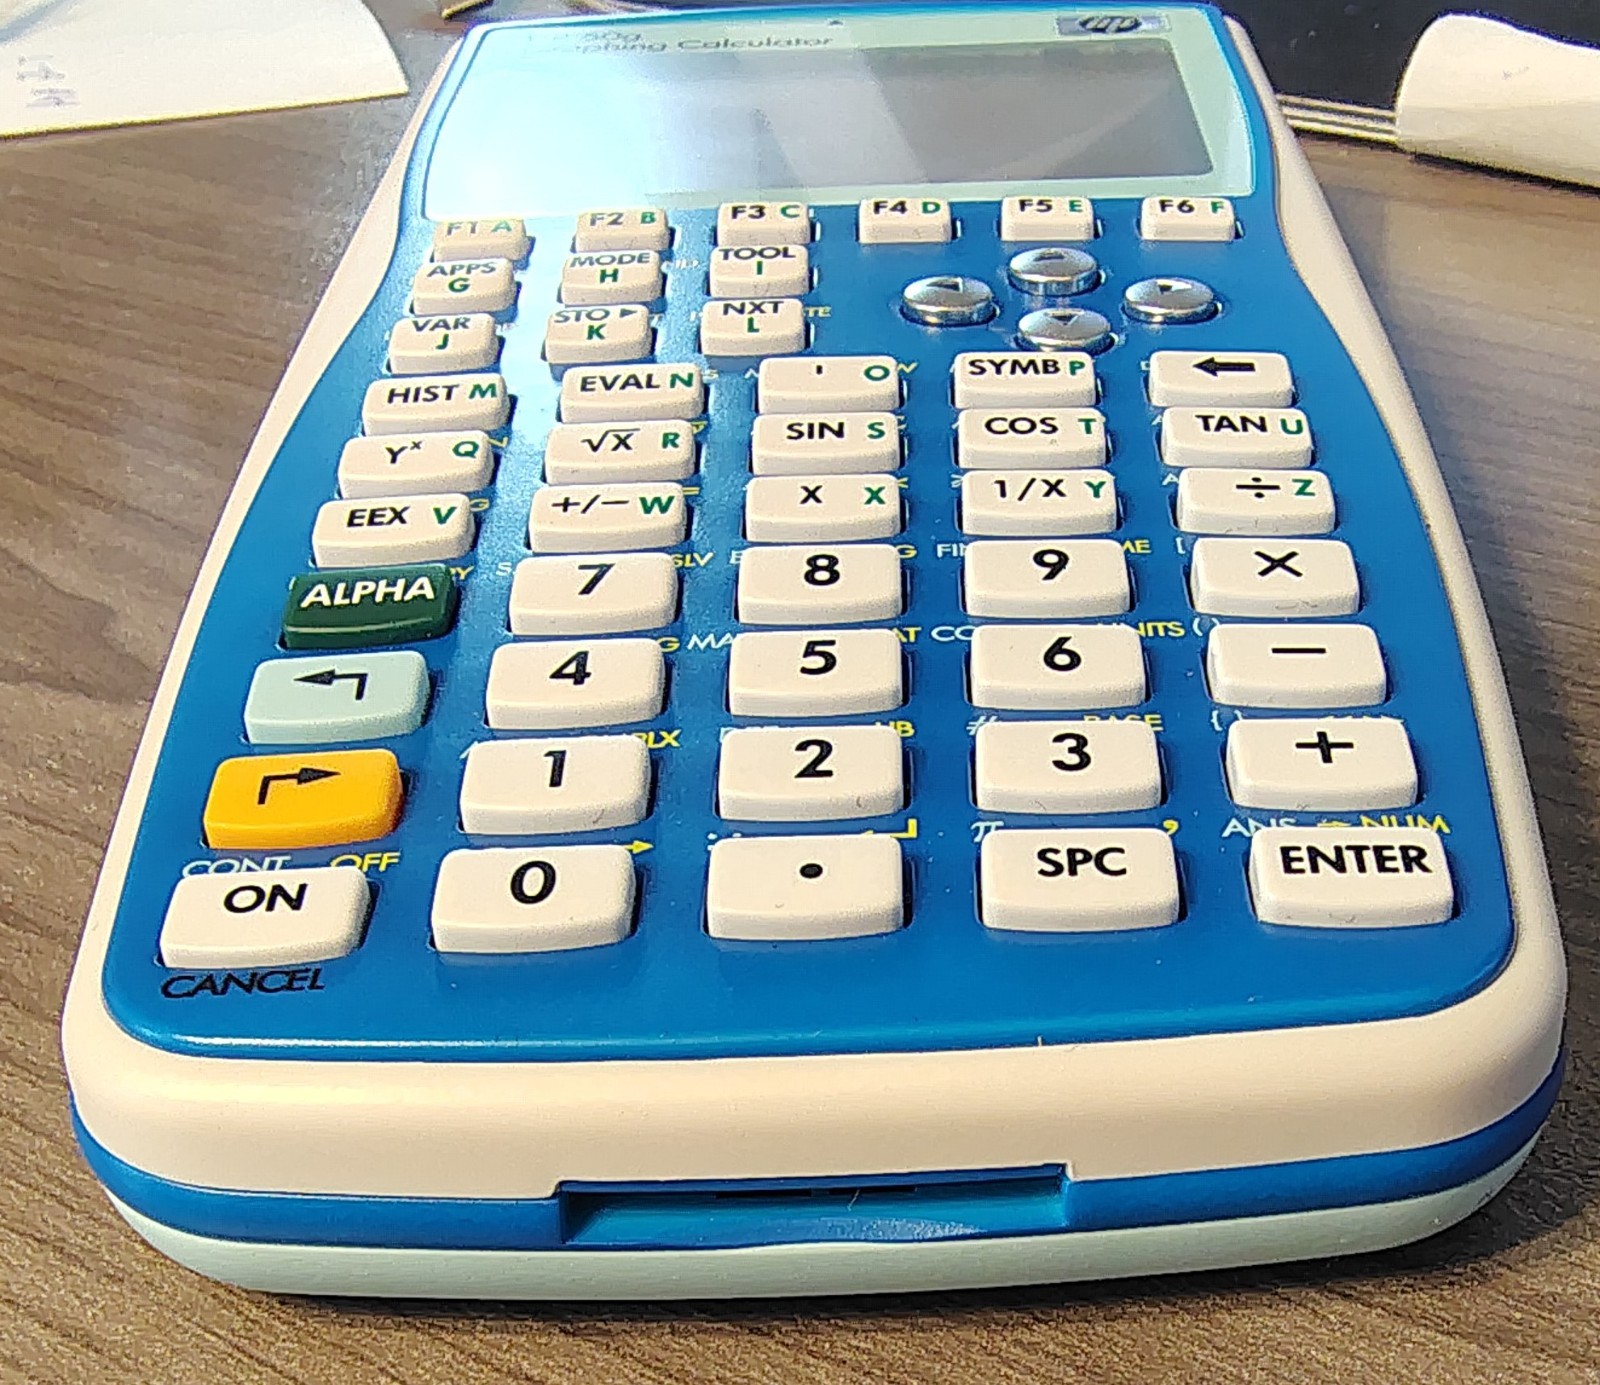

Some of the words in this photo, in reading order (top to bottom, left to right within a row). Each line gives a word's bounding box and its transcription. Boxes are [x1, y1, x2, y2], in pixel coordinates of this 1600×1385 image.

[677, 37, 834, 50] Calculator
[731, 205, 765, 219] F3
[780, 205, 800, 218] C
[873, 200, 907, 214] F4
[922, 201, 941, 214] D
[1019, 199, 1053, 212] F5
[1069, 200, 1083, 213] E
[1159, 200, 1195, 213] F6
[1211, 201, 1225, 213] F
[590, 211, 623, 226] F2
[640, 211, 656, 225] B
[446, 221, 477, 237] F1
[491, 220, 513, 233] A
[570, 252, 650, 267] MODE
[719, 247, 796, 260] TOOL
[427, 261, 497, 276] APPS
[600, 269, 619, 283] H
[448, 278, 470, 293] G
[554, 309, 610, 323] STO
[723, 301, 784, 315] NXT
[413, 317, 471, 332] VAR
[587, 325, 605, 340] K
[747, 317, 760, 332] L
[435, 335, 450, 350] J
[864, 365, 890, 381] O
[968, 359, 1061, 376] SYMB
[1068, 361, 1086, 375] P
[580, 375, 660, 392] EVAL
[669, 373, 694, 388] N
[388, 385, 460, 404] HIST
[468, 383, 497, 400] M
[786, 422, 845, 440] SIN
[867, 422, 886, 439] S
[985, 418, 1059, 434] COS
[1078, 418, 1097, 434] T
[1196, 415, 1268, 432] TAN
[1280, 418, 1304, 435] U
[661, 432, 680, 449] R
[453, 441, 479, 459] Q
[800, 485, 823, 504] X
[864, 486, 887, 505] X
[994, 477, 1067, 501] 1/X
[1084, 481, 1107, 498] Y
[1291, 479, 1316, 496] Z
[639, 495, 675, 515] W
[347, 506, 410, 527] EEX
[433, 506, 457, 524] V
[803, 553, 841, 586] 8
[1033, 549, 1070, 581] 9
[576, 563, 616, 595] 7
[300, 576, 436, 608] ALPHA
[800, 639, 837, 676] 5
[1043, 636, 1083, 672] 6
[548, 650, 593, 685] 4
[794, 738, 834, 778] 2
[1052, 733, 1092, 771] 3
[543, 750, 567, 788] 1
[182, 855, 293, 877] CONT
[330, 852, 401, 873] OFF
[1037, 847, 1127, 878] SPC
[1280, 844, 1434, 875] ENTER
[510, 860, 557, 905] 0
[223, 883, 309, 914] ON
[162, 968, 326, 999] CANCEL
